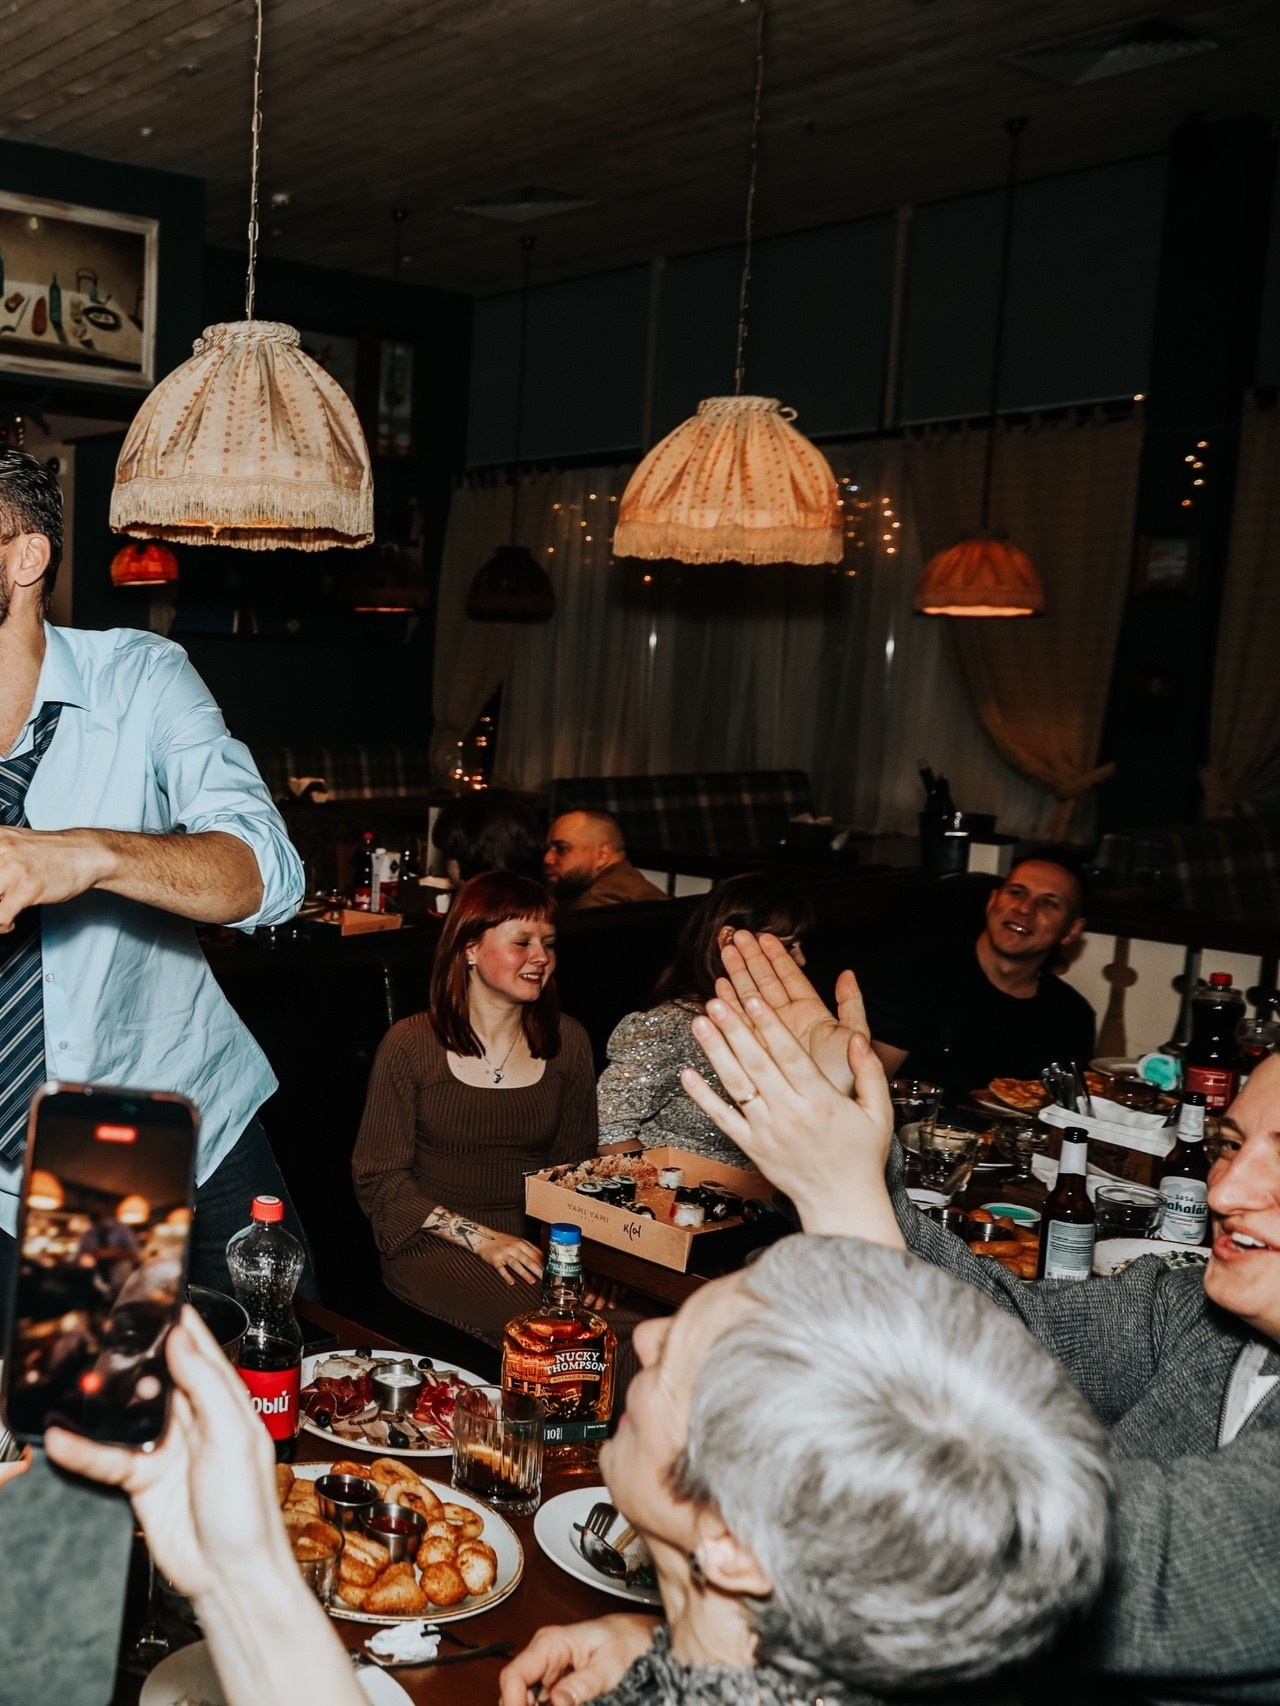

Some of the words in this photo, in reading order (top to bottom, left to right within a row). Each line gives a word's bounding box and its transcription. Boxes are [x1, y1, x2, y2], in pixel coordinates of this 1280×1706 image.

[555, 1351, 600, 1363] NUCKY
[544, 1361, 606, 1375] THOMPSON
[546, 1429, 556, 1440] 10
